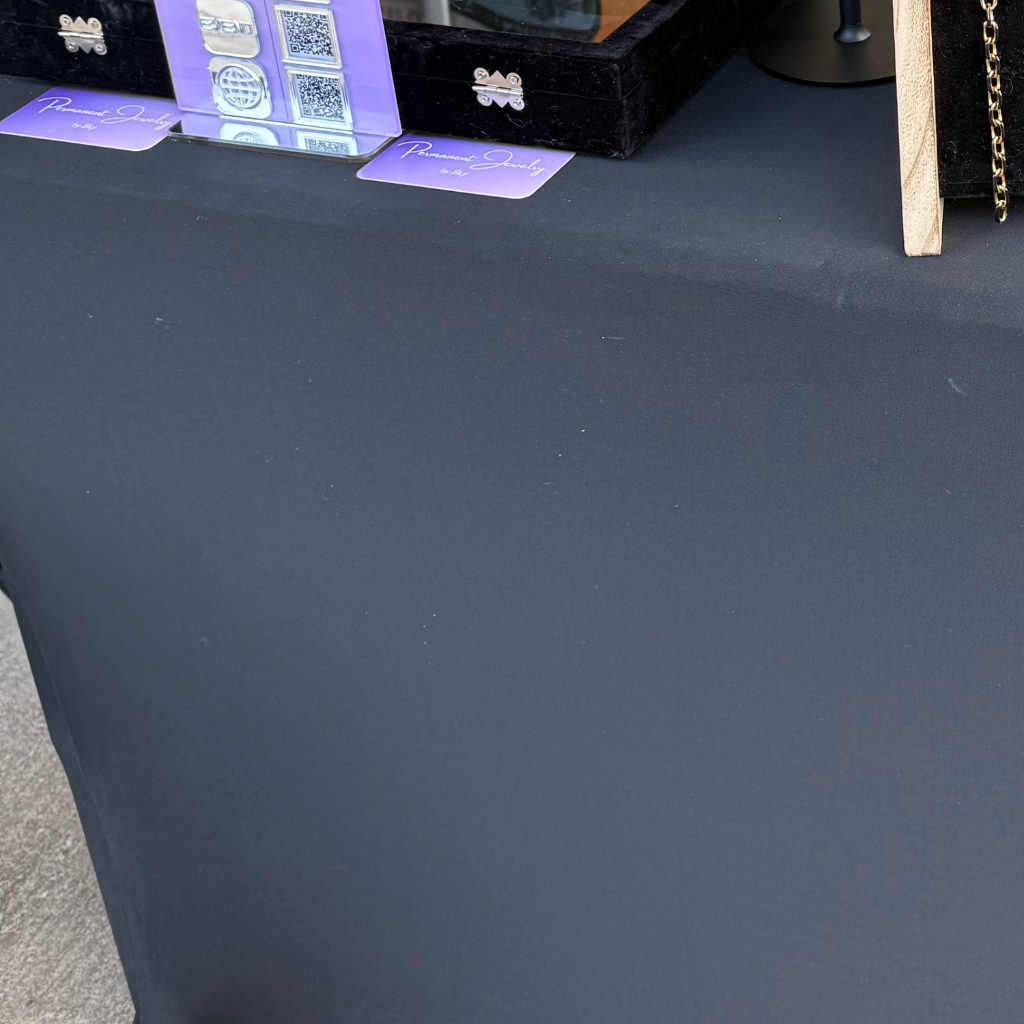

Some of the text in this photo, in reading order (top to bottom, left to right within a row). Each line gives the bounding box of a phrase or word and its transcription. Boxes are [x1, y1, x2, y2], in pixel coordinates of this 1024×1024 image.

[38, 96, 173, 131] Permanent Jewelry
[398, 140, 547, 177] Permanent Jewelry
